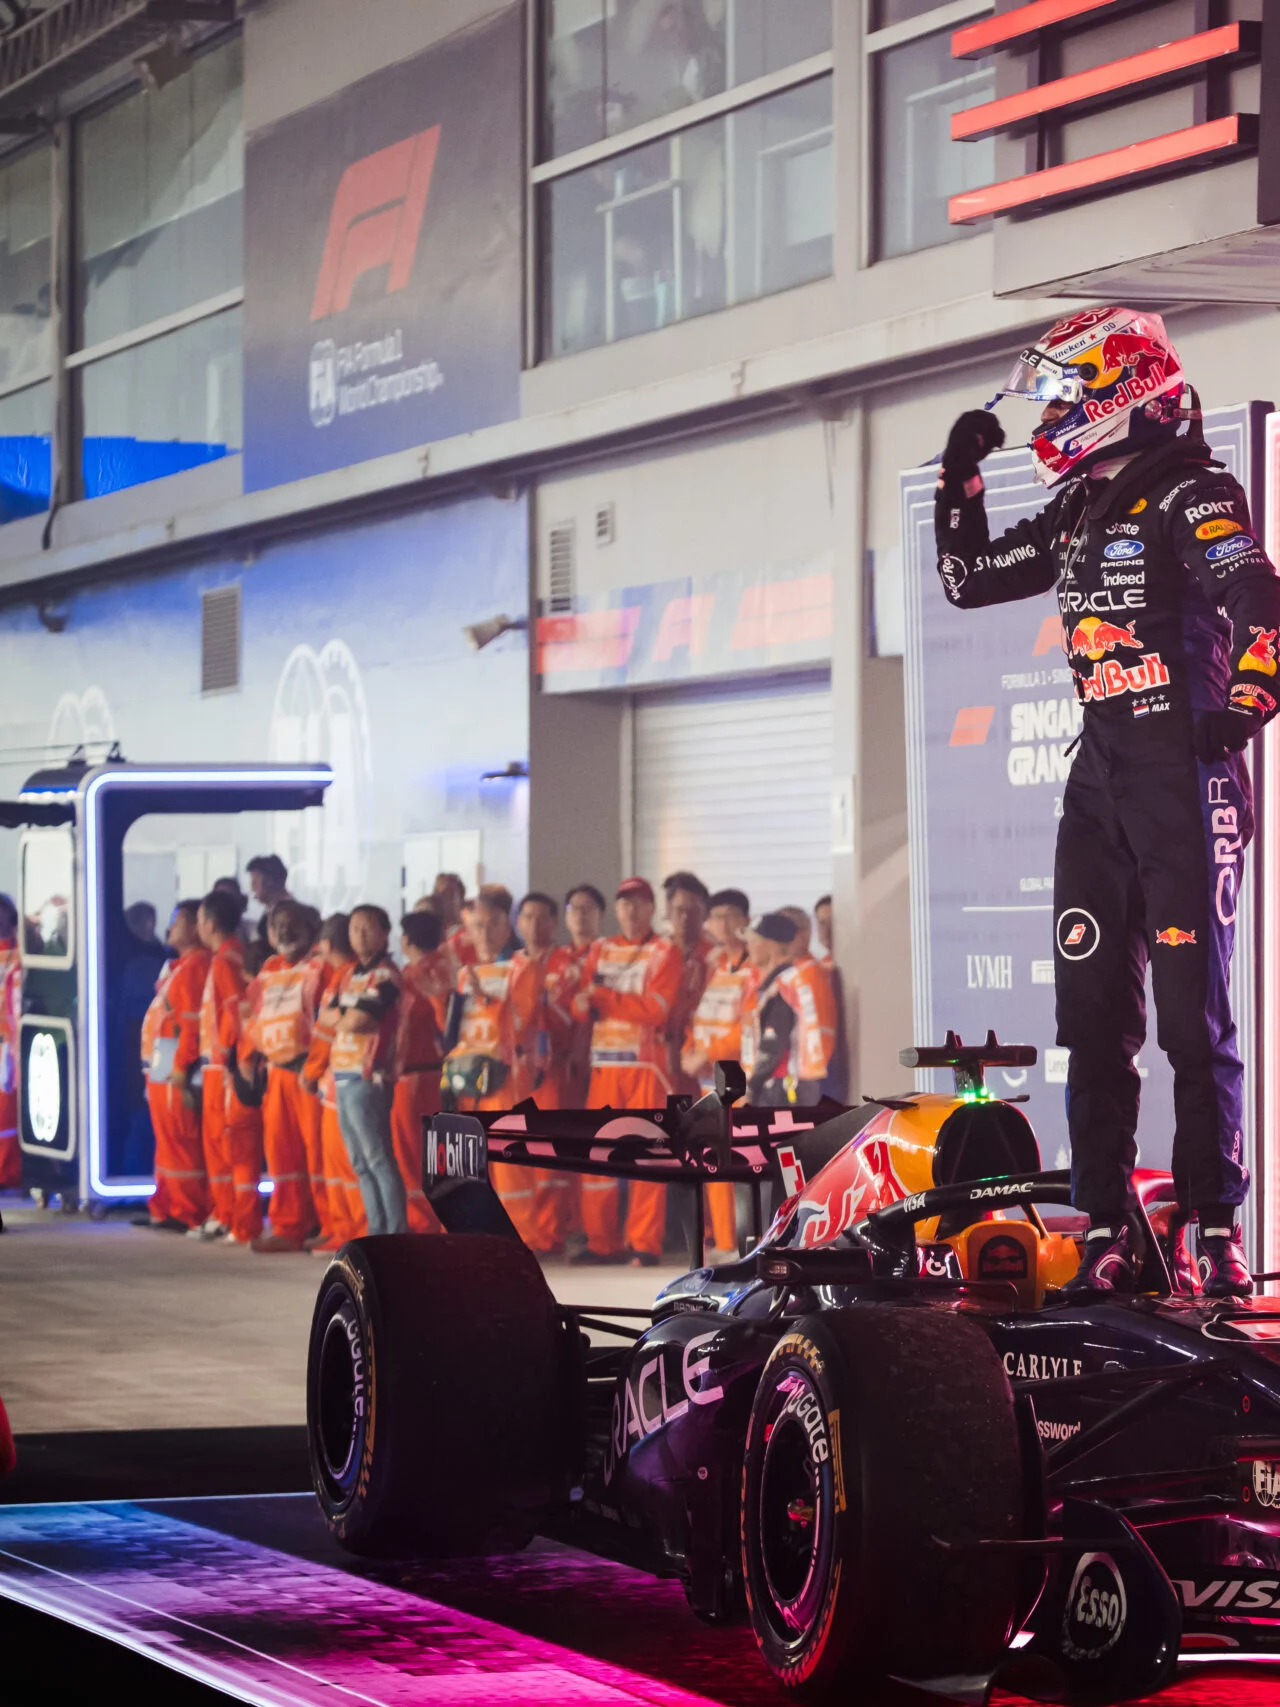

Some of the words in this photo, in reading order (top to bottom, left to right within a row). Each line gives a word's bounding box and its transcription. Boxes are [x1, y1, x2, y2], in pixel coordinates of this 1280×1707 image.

[1084, 382, 1130, 422] Red
[1125, 362, 1166, 400] Bull
[1184, 501, 1234, 524] ROKT
[1110, 542, 1136, 557] Ford
[1215, 538, 1244, 557] Ford
[1101, 559, 1144, 568] RACING
[1103, 571, 1145, 587] indeed
[1103, 653, 1171, 698] Bull
[1151, 702, 1170, 712] MAX
[967, 955, 1013, 989] LVMH
[427, 1130, 464, 1179] Mobil
[970, 1182, 1034, 1199] DAMAC
[904, 1193, 926, 1213] VISA
